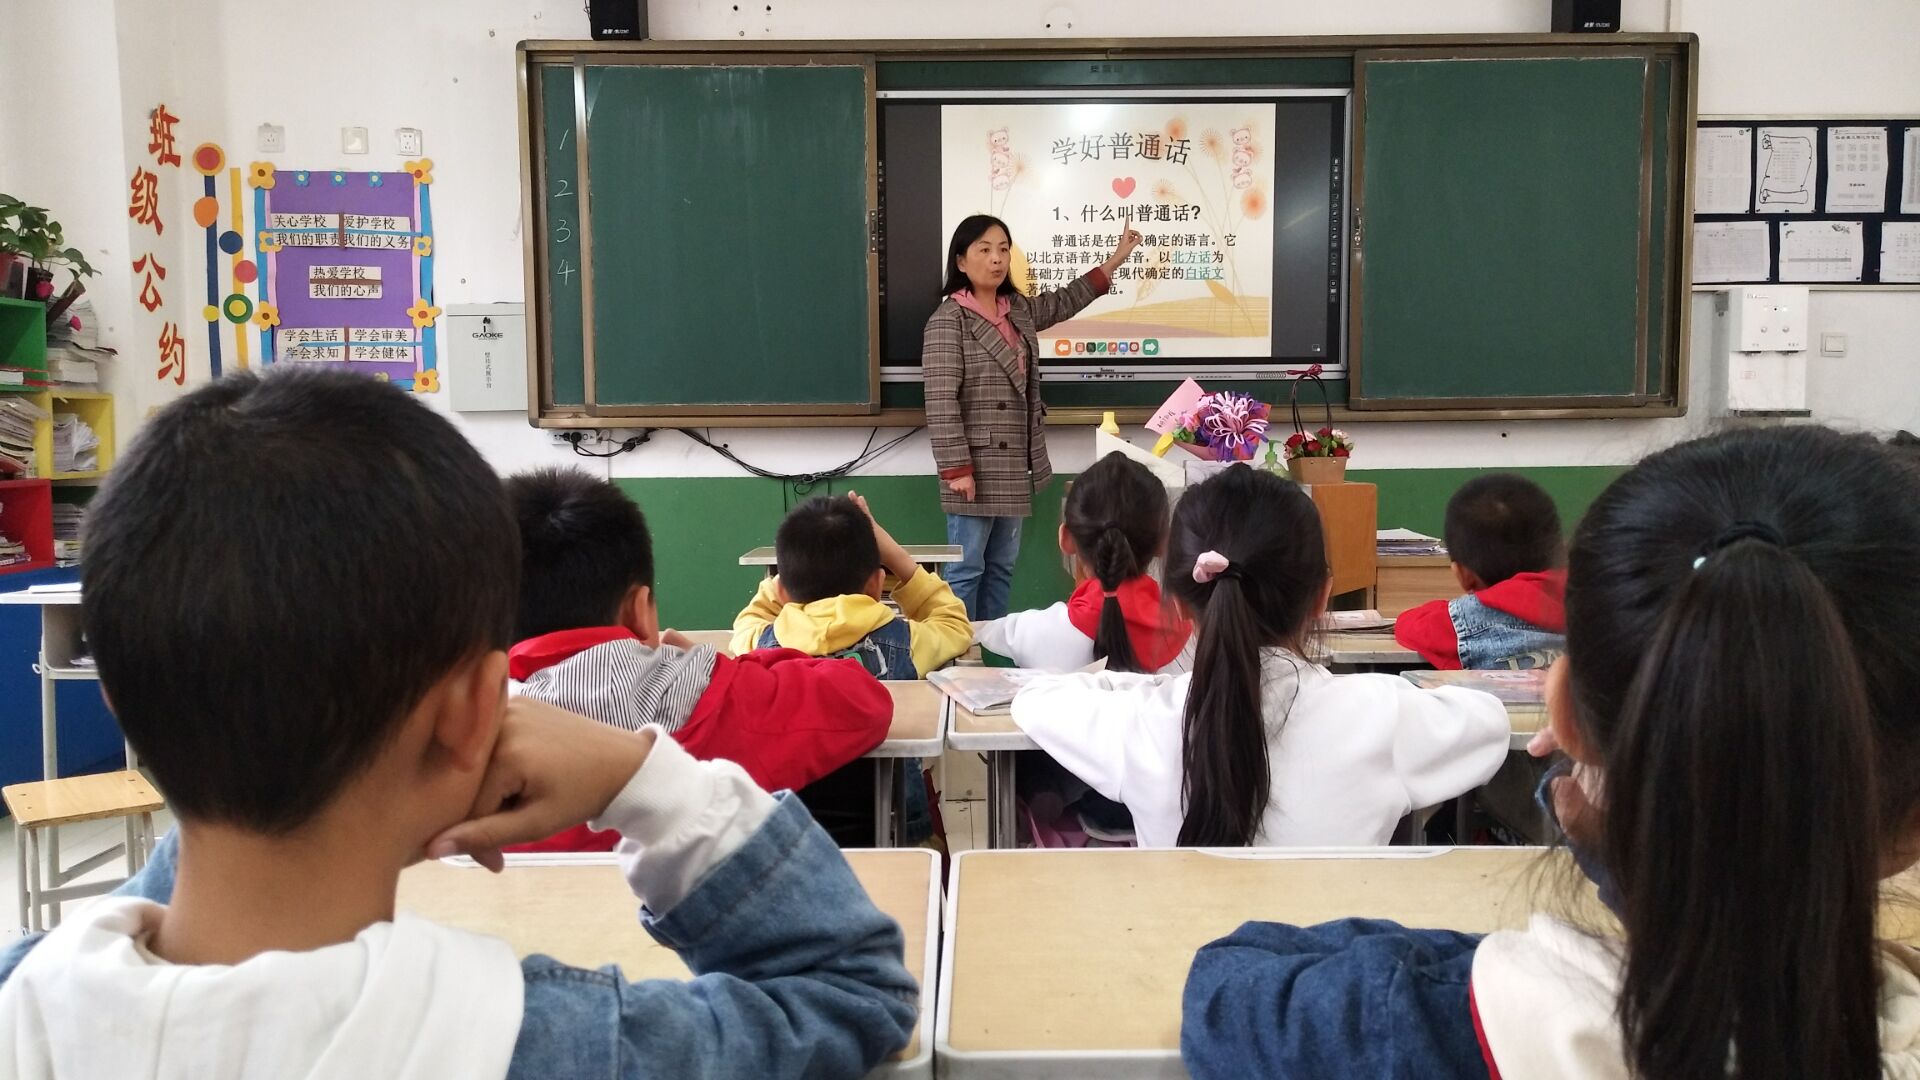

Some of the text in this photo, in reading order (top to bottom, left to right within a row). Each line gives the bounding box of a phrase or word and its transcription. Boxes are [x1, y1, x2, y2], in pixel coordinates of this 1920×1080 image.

[1051, 132, 1191, 166] 学好普通话
[554, 179, 574, 198] 2
[274, 215, 327, 228] 关心学校
[344, 216, 396, 230] 爱护学校
[556, 219, 571, 243] 3
[129, 104, 187, 386] 班级公约
[277, 233, 340, 246] 我们的职责
[344, 234, 409, 249] 我们的义务
[1051, 233, 1237, 248] 普通话是在确定的语言。它
[313, 267, 366, 280] 热爱学校
[556, 259, 576, 286] 4
[313, 284, 379, 297] 我们的心声
[284, 329, 338, 342] 学会生活
[354, 329, 408, 342] 学会审美
[285, 346, 339, 360] 学会求知
[355, 346, 408, 359] 学会健体
